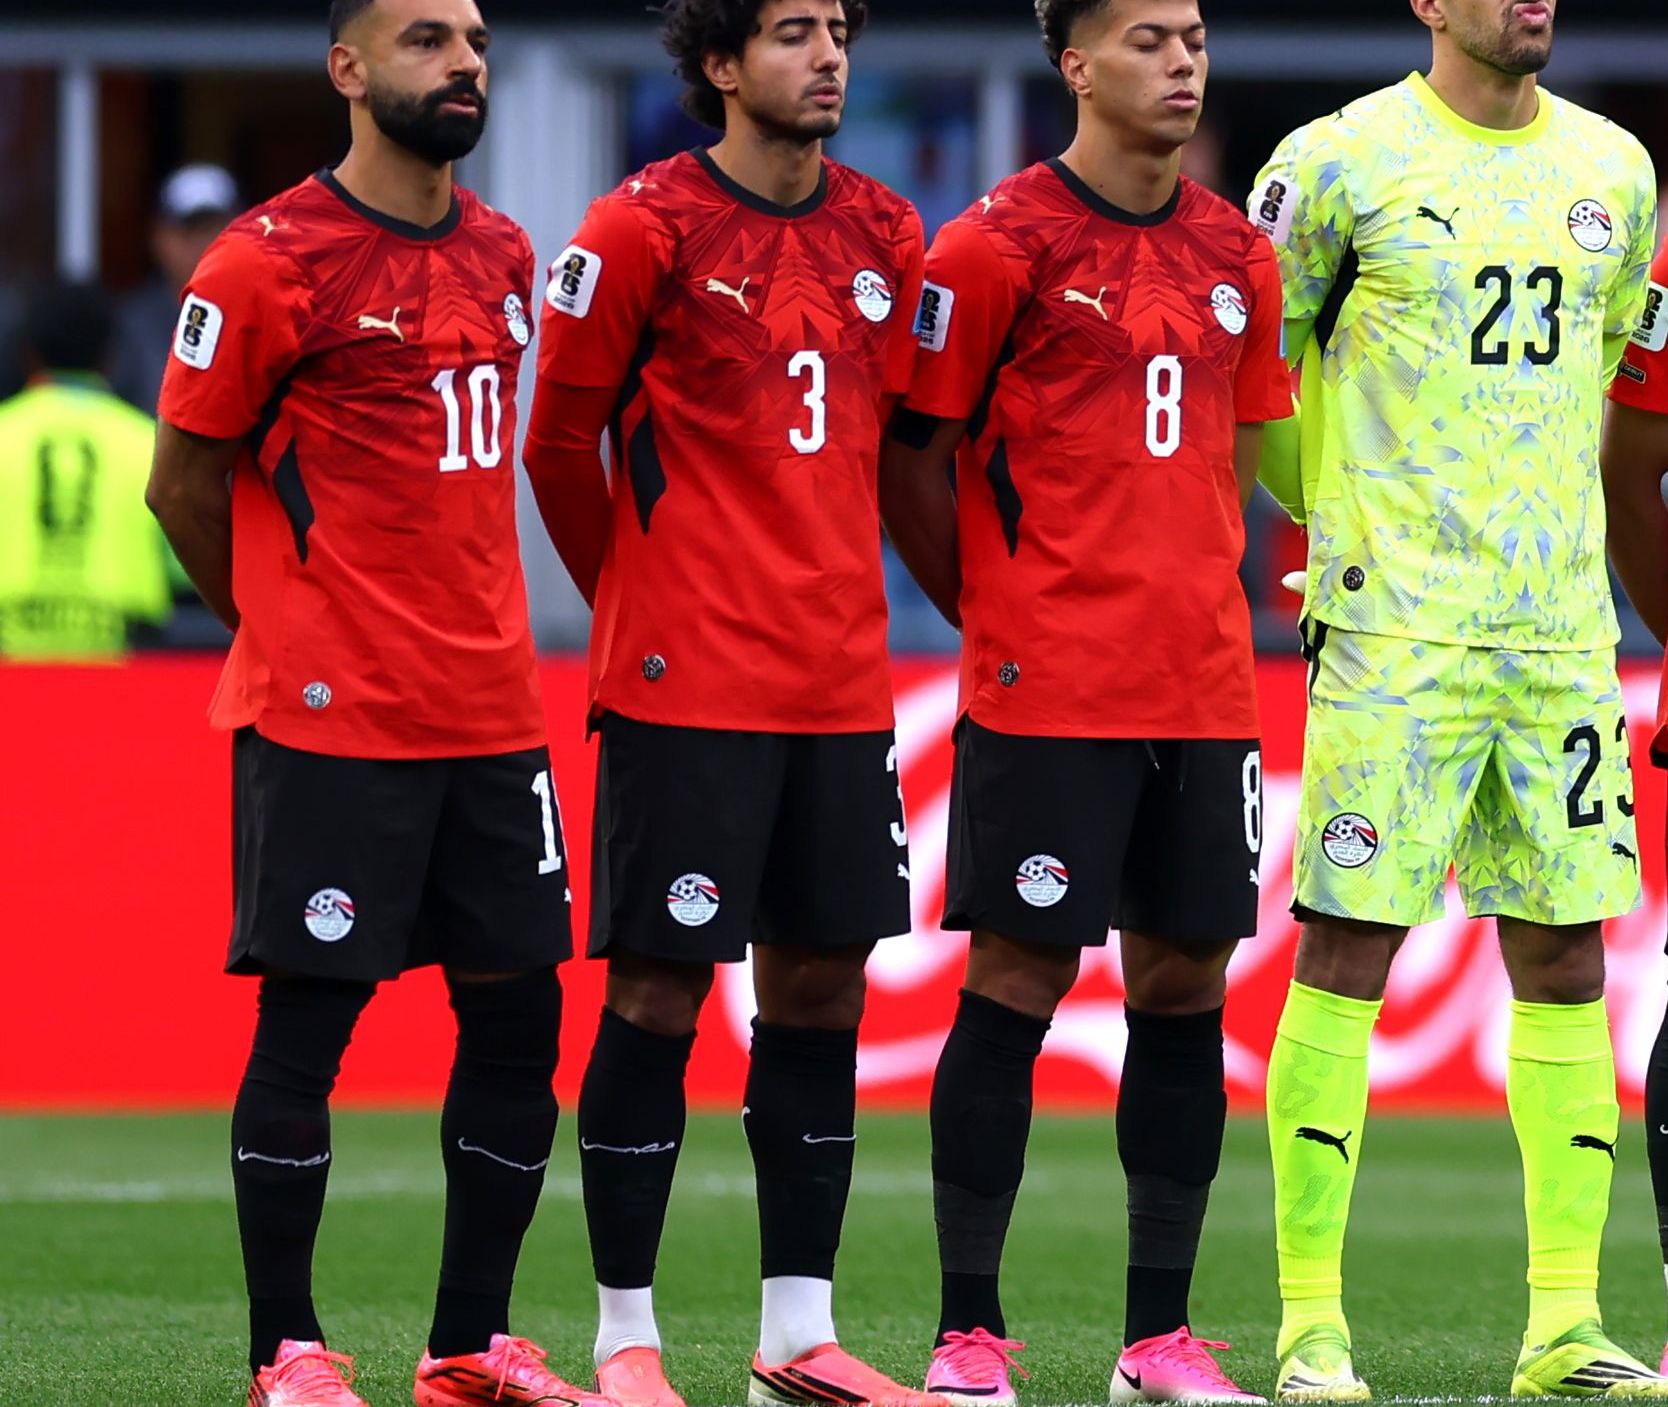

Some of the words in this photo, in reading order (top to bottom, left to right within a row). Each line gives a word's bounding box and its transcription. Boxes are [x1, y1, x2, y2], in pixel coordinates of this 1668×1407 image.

[1470, 265, 1563, 366] 23
[431, 364, 502, 472] 10
[788, 350, 826, 454] 3
[1145, 354, 1183, 458] 8
[531, 770, 563, 875] 1
